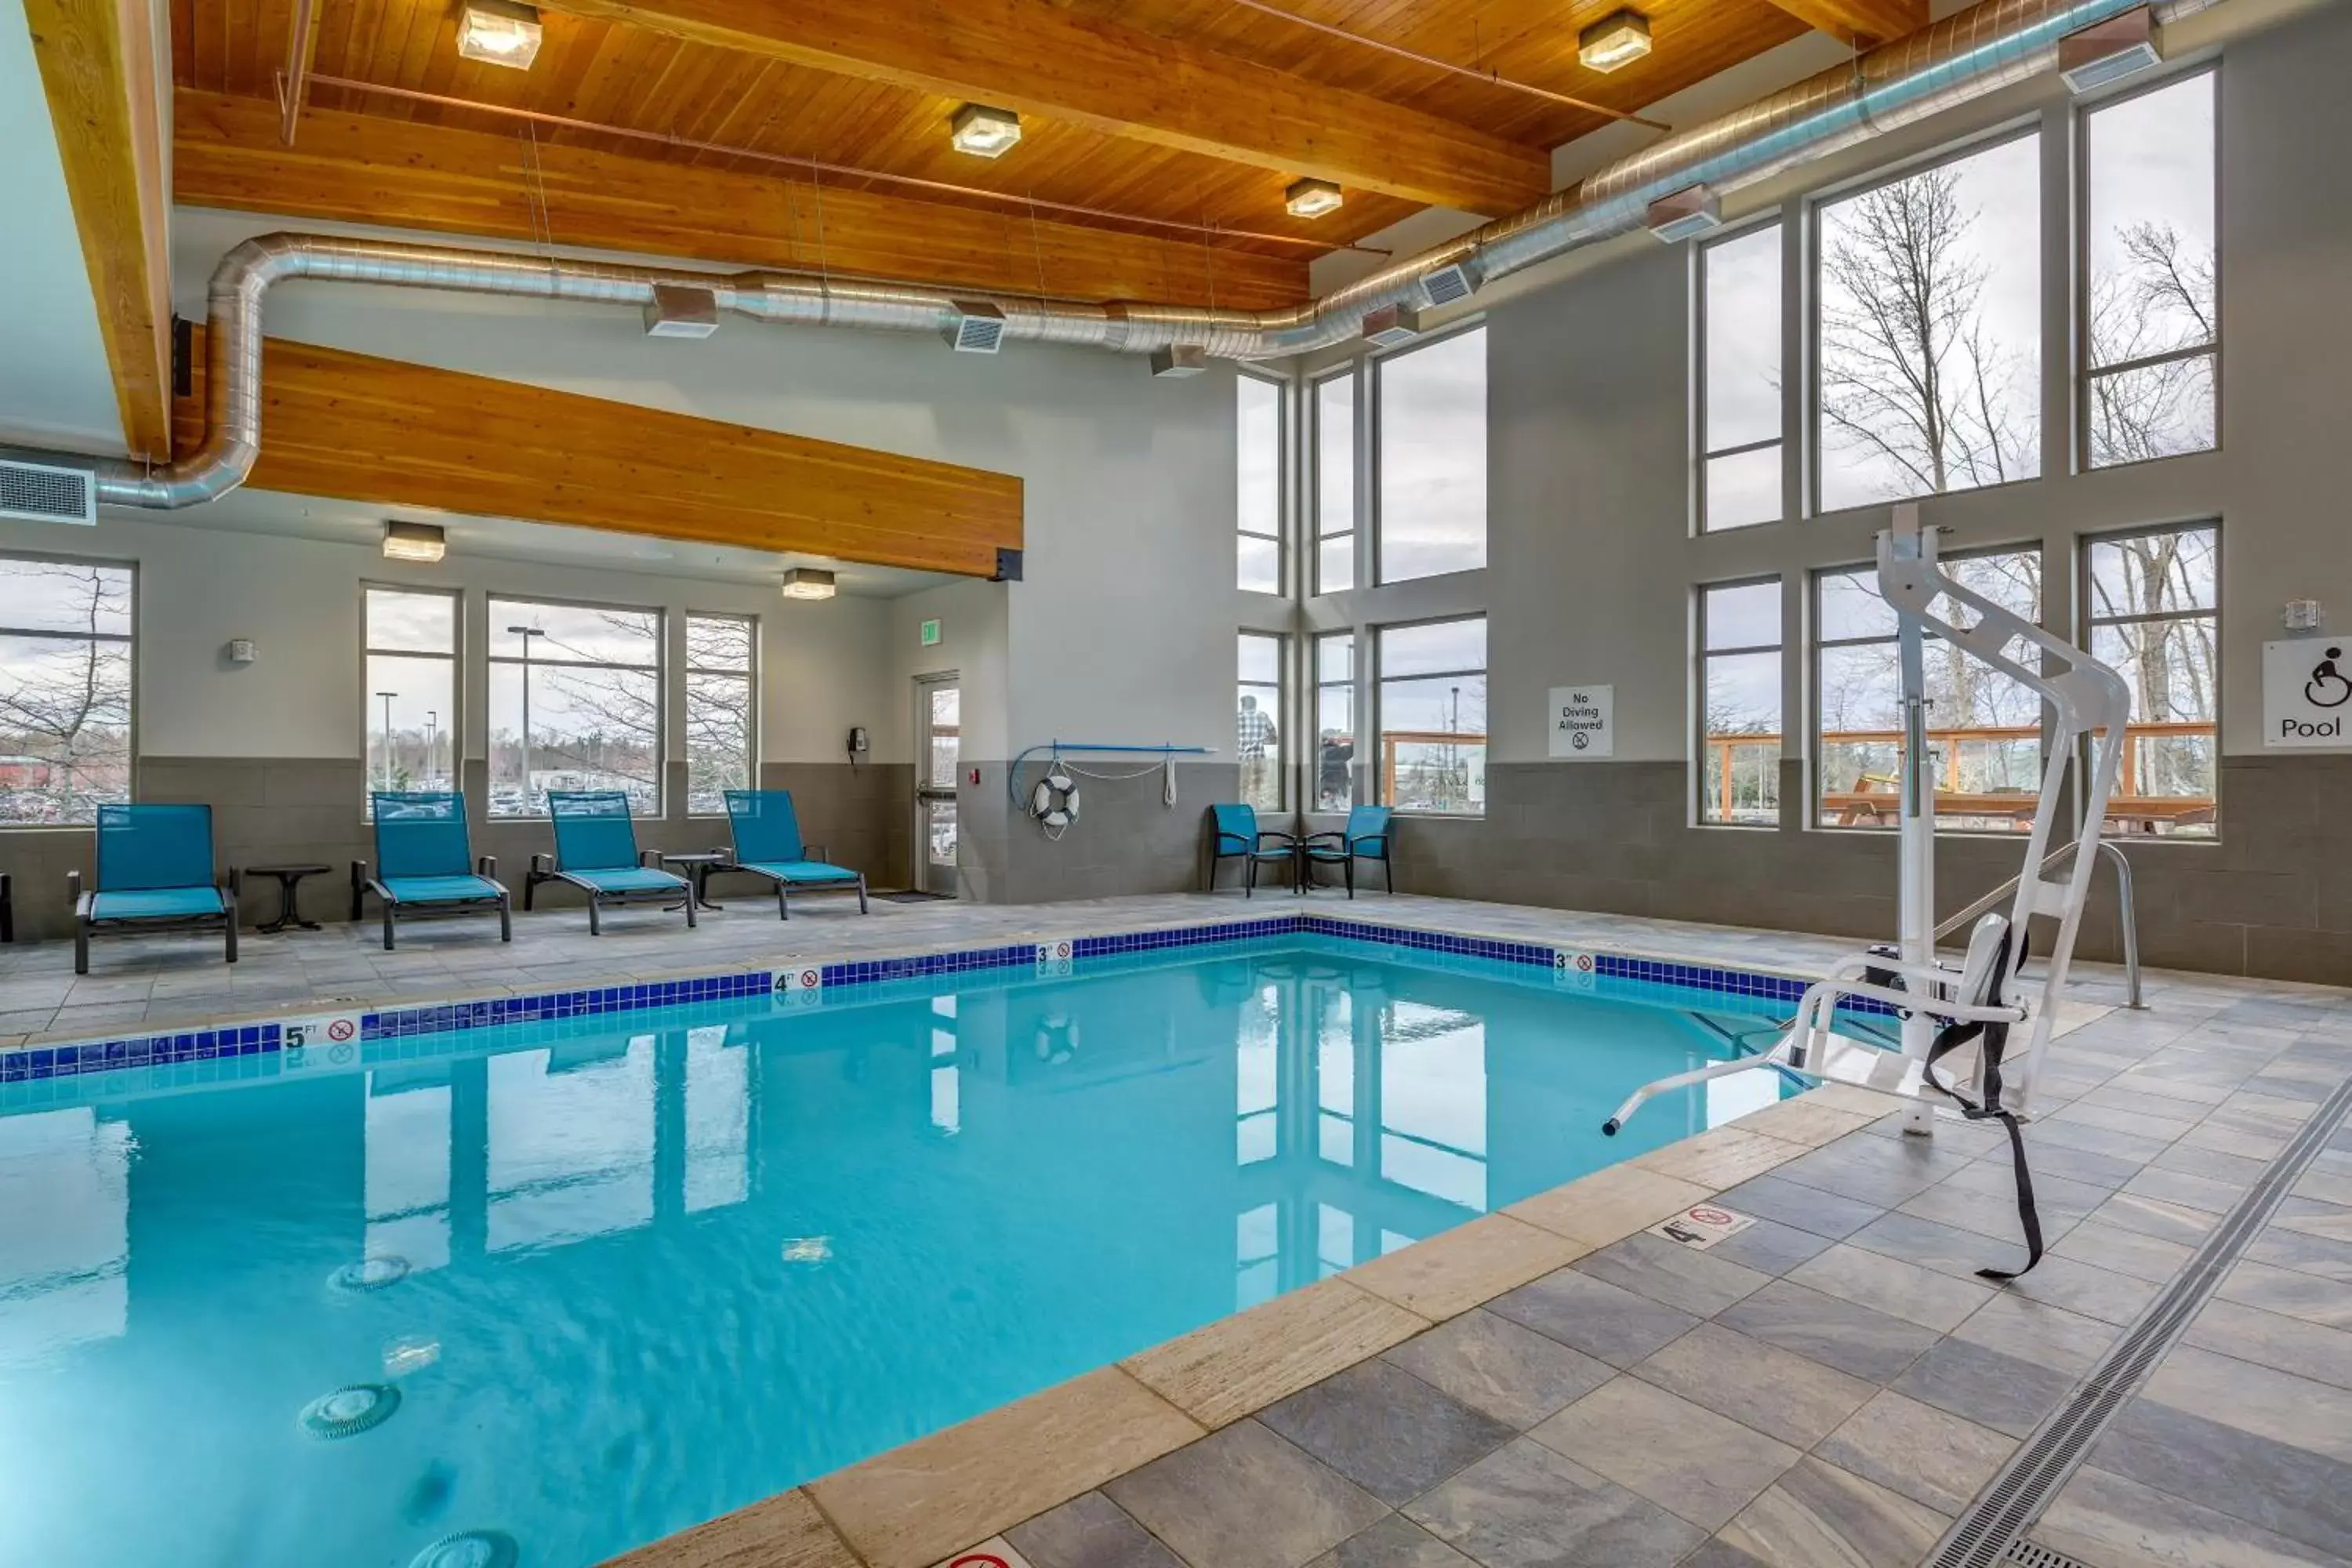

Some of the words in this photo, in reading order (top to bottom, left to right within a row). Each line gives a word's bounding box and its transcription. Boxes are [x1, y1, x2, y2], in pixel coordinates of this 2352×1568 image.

[1573, 693, 1588, 702] No
[1563, 707, 1599, 719] Diving
[1559, 720, 1603, 730] Allowed
[2282, 717, 2340, 737] Pool
[1039, 946, 1047, 962] 3
[1556, 953, 1566, 968] 3
[775, 975, 787, 992] 4
[286, 1026, 305, 1048] 5
